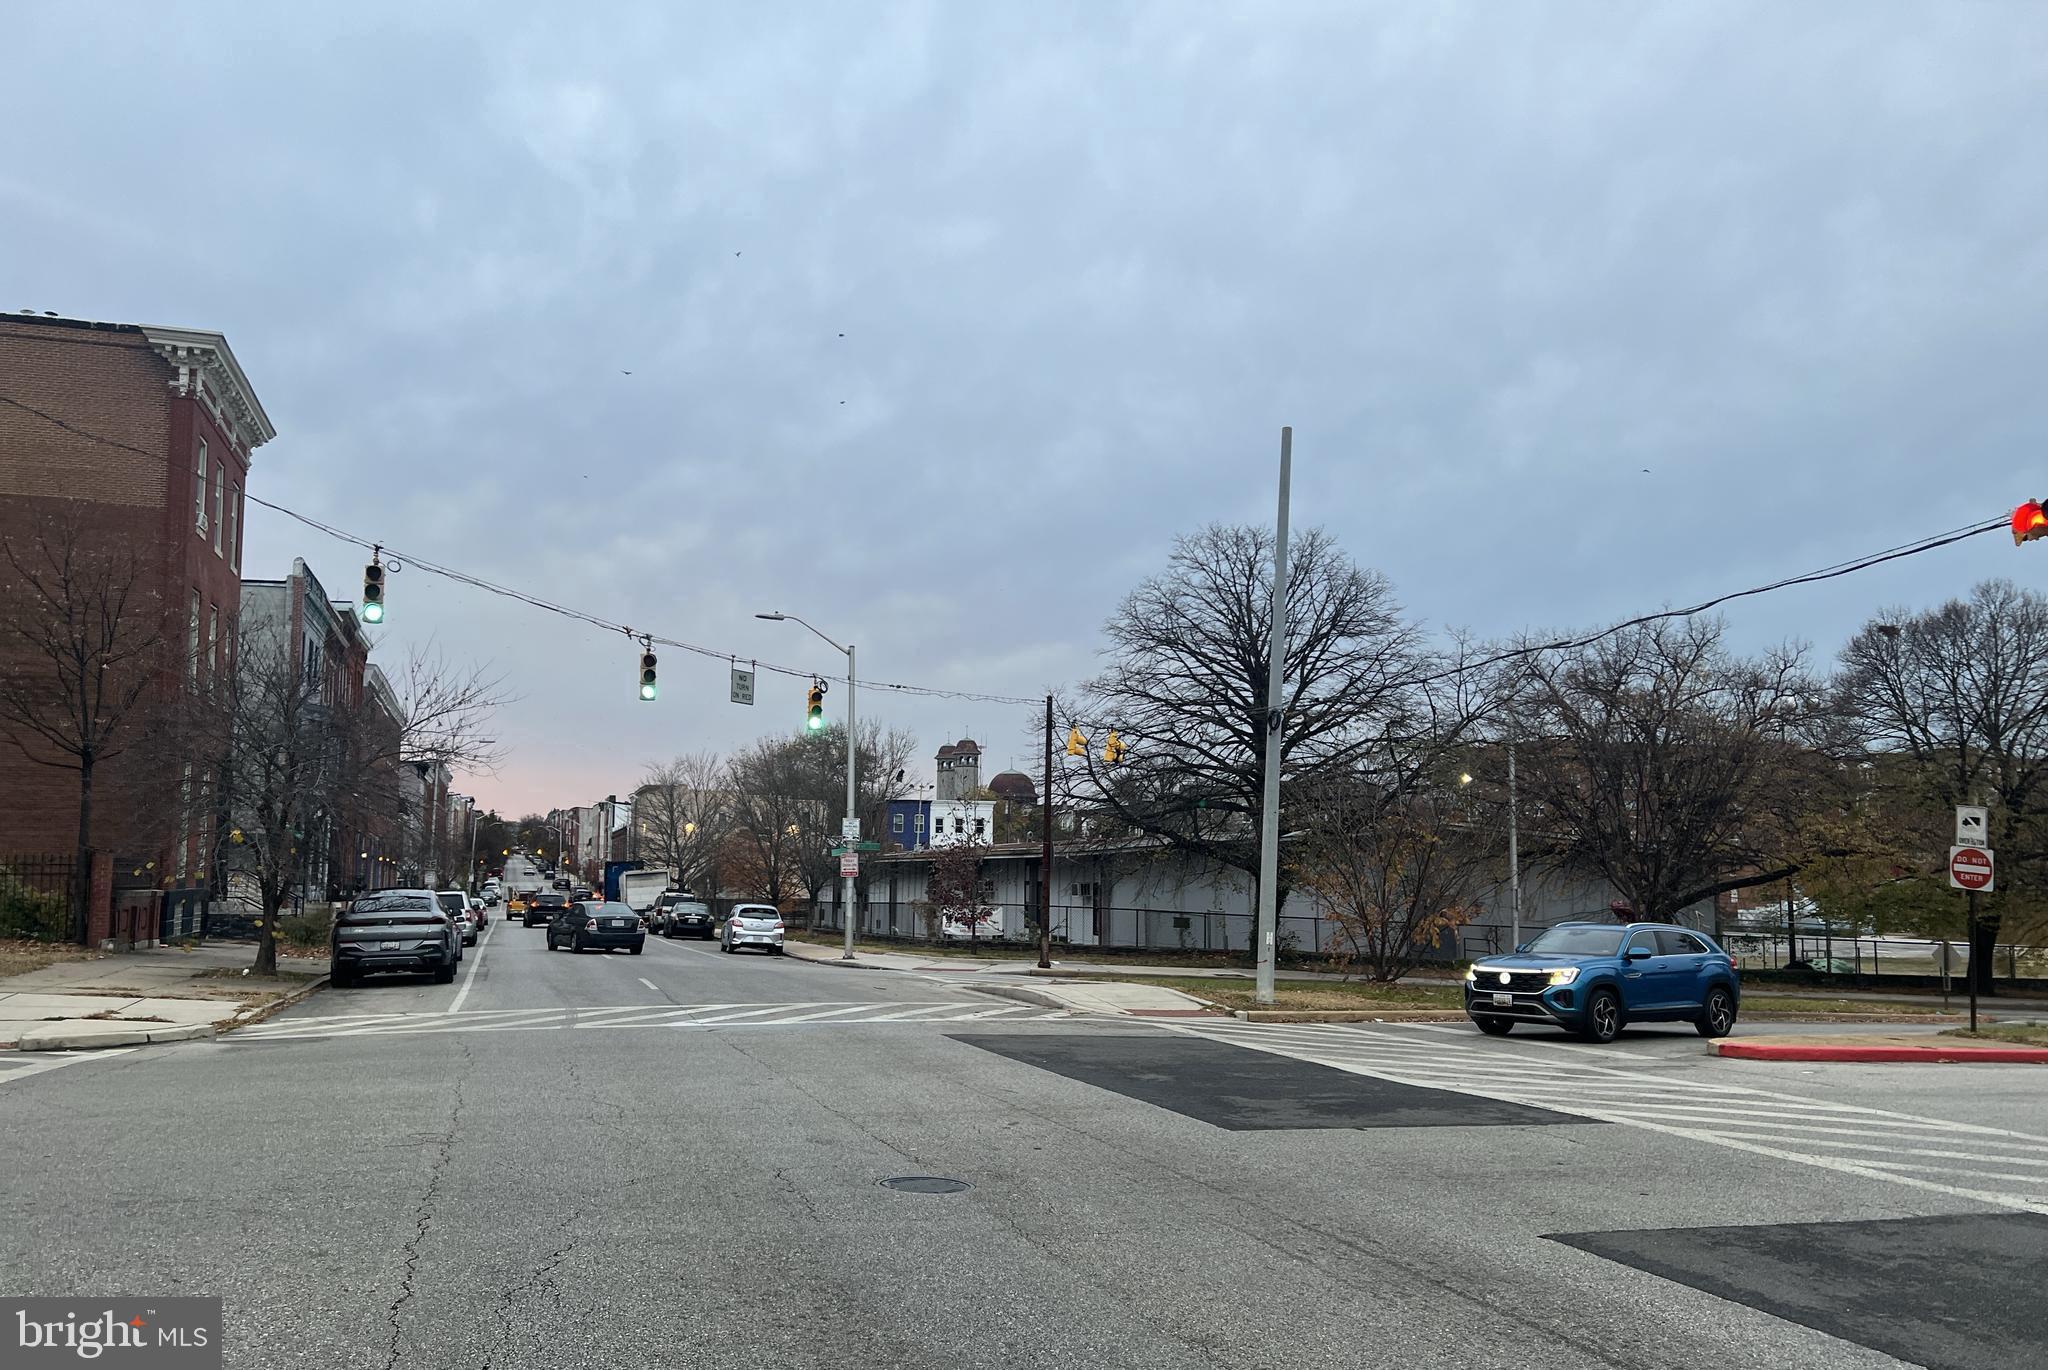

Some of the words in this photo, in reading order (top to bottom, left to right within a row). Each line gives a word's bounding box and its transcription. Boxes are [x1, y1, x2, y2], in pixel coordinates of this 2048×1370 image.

[738, 674, 747, 682] NO
[736, 682, 750, 691] TURN
[742, 693, 752, 701] RED
[1956, 855, 1968, 863] DO
[1972, 857, 1987, 865] NOT
[1960, 873, 1984, 882] ENTER
